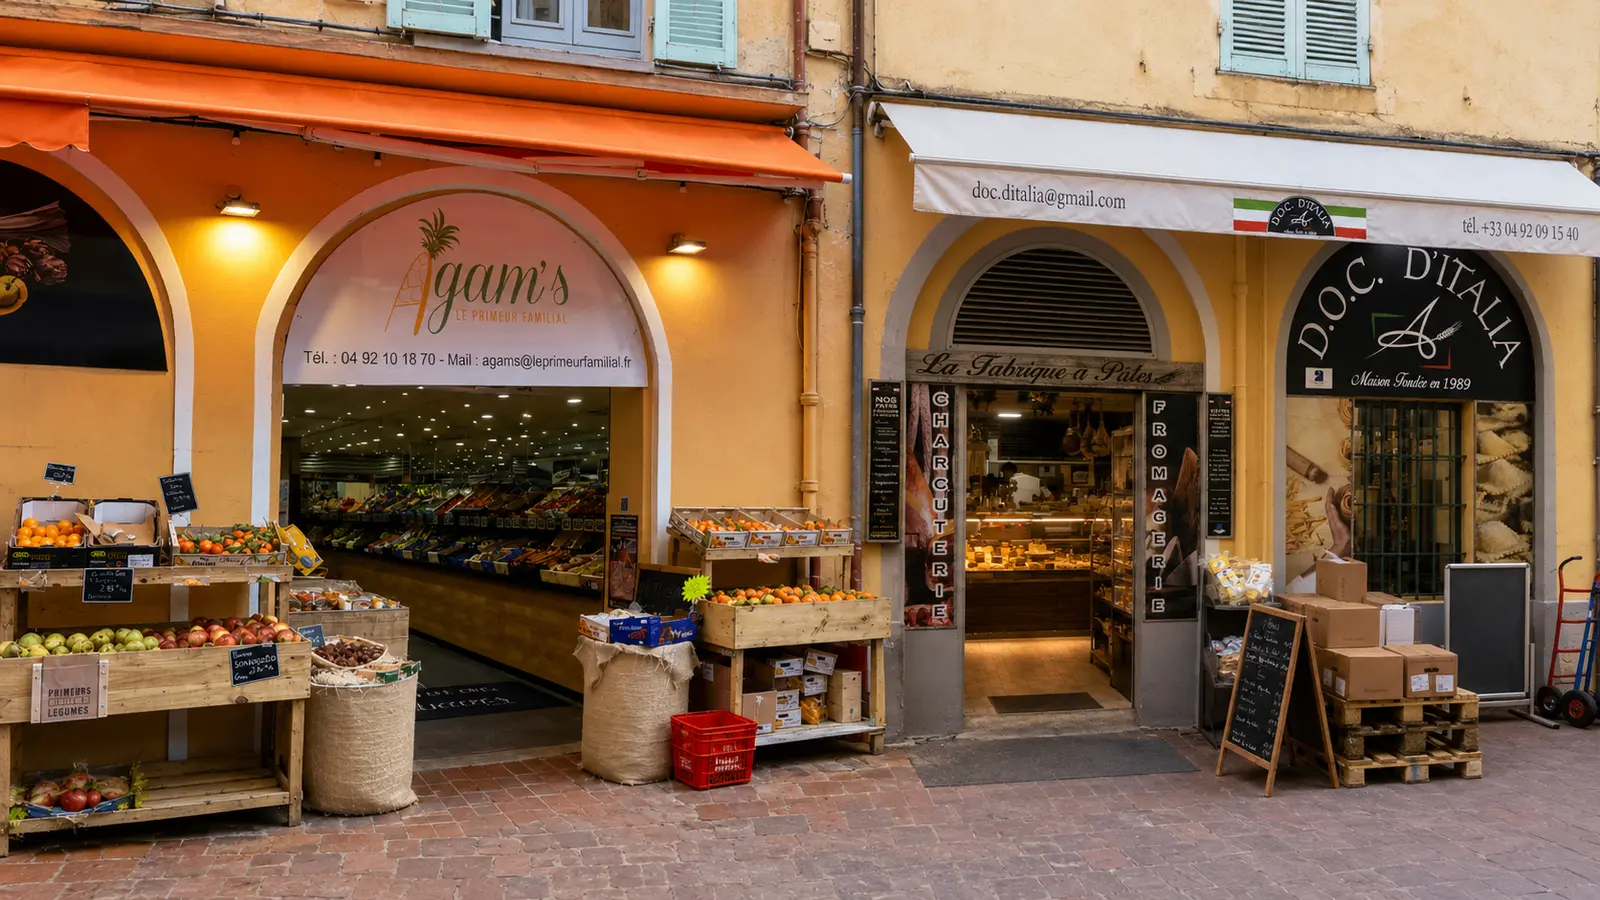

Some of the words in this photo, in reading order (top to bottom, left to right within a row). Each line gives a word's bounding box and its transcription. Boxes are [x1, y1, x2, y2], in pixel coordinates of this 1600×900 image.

[972, 180, 1126, 210] doc.ditalia@gmail.com
[1462, 216, 1479, 234] tél.
[1481, 220, 1502, 237] +33
[1504, 222, 1517, 237] 04
[1520, 223, 1533, 238] 92
[1535, 224, 1548, 239] 09
[1552, 225, 1564, 241] 15
[1566, 226, 1579, 241] 40
[455, 309, 468, 321] LE
[472, 309, 518, 323] PRIMEUR
[522, 311, 568, 325] FAMILIAL
[1297, 255, 1384, 361] D.O.C.
[1403, 246, 1522, 370] D'ITALIA
[303, 350, 328, 364] Tél.
[341, 351, 358, 365] 04
[362, 351, 378, 365] 92
[382, 352, 398, 366] 10
[402, 352, 417, 366] 18
[420, 352, 436, 366] 70
[447, 353, 472, 366] Mail
[482, 354, 632, 370] agams@leprimeurfamilial.fr
[915, 352, 960, 376] La
[966, 354, 1068, 384] Fabrique
[1350, 370, 1391, 387] Maison
[1393, 371, 1428, 389] Fondée
[1429, 379, 1440, 389] en
[1443, 377, 1471, 390] 1989
[931, 391, 949, 623] CHARCUTERIE
[1151, 400, 1168, 613] FROMAGERIE
[48, 686, 92, 697] PRIMEURS
